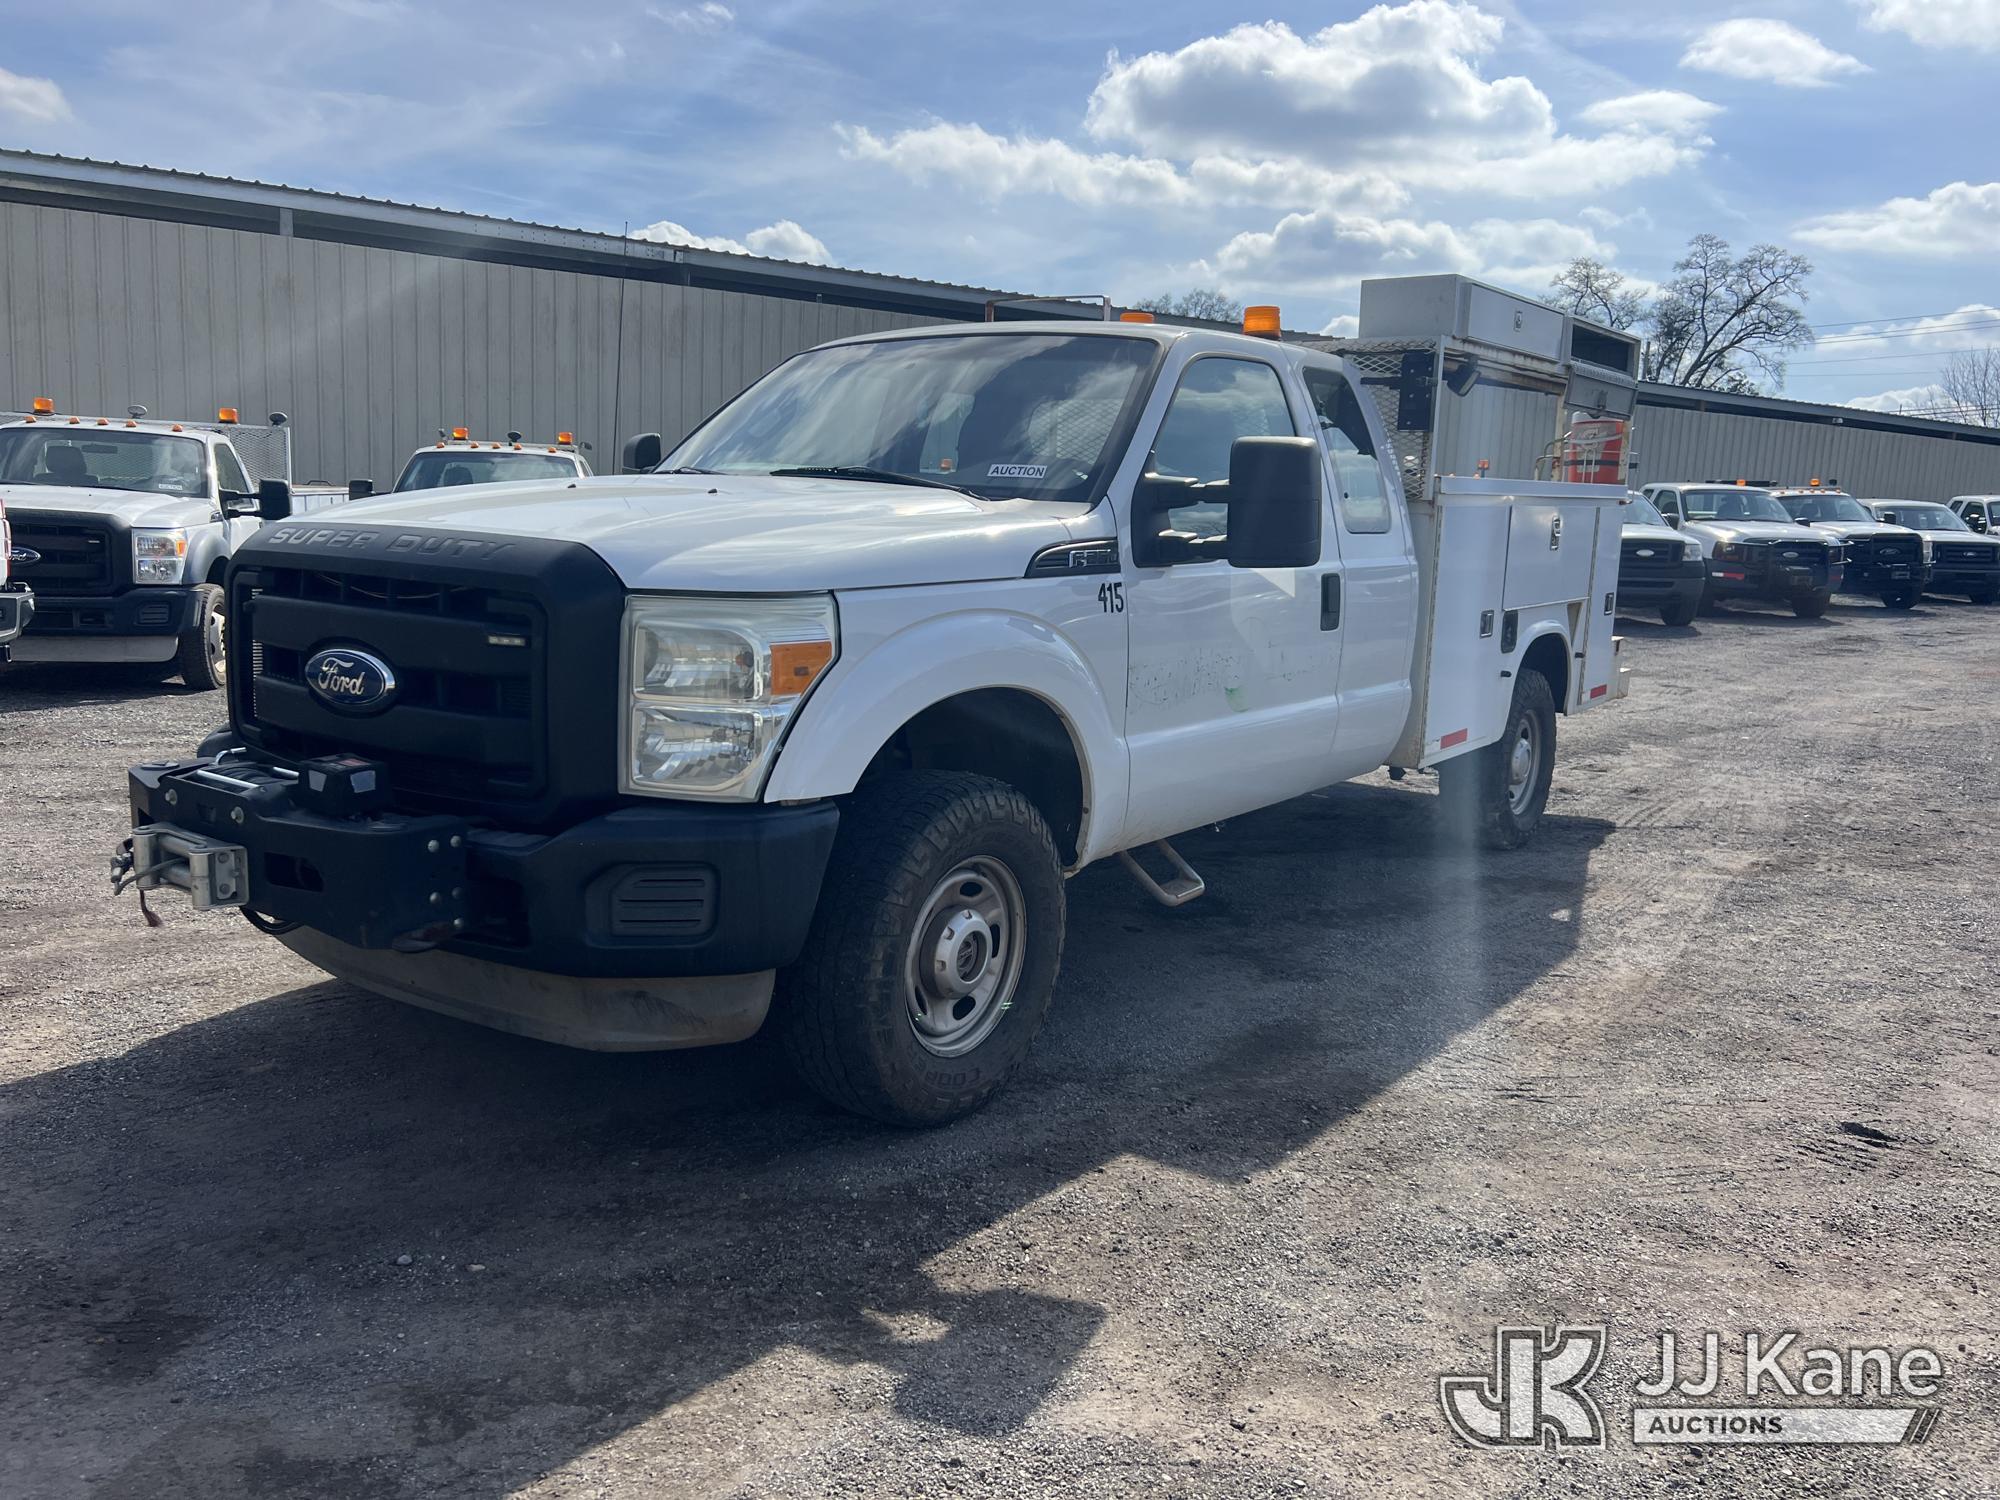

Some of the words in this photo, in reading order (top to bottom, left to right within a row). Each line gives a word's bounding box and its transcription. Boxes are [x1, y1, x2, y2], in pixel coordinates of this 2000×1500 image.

[990, 466, 1045, 477] AUCTION
[268, 527, 378, 549] SUPER
[386, 535, 515, 560] DUTY
[1098, 582, 1124, 613] 415
[318, 656, 366, 695] Ford
